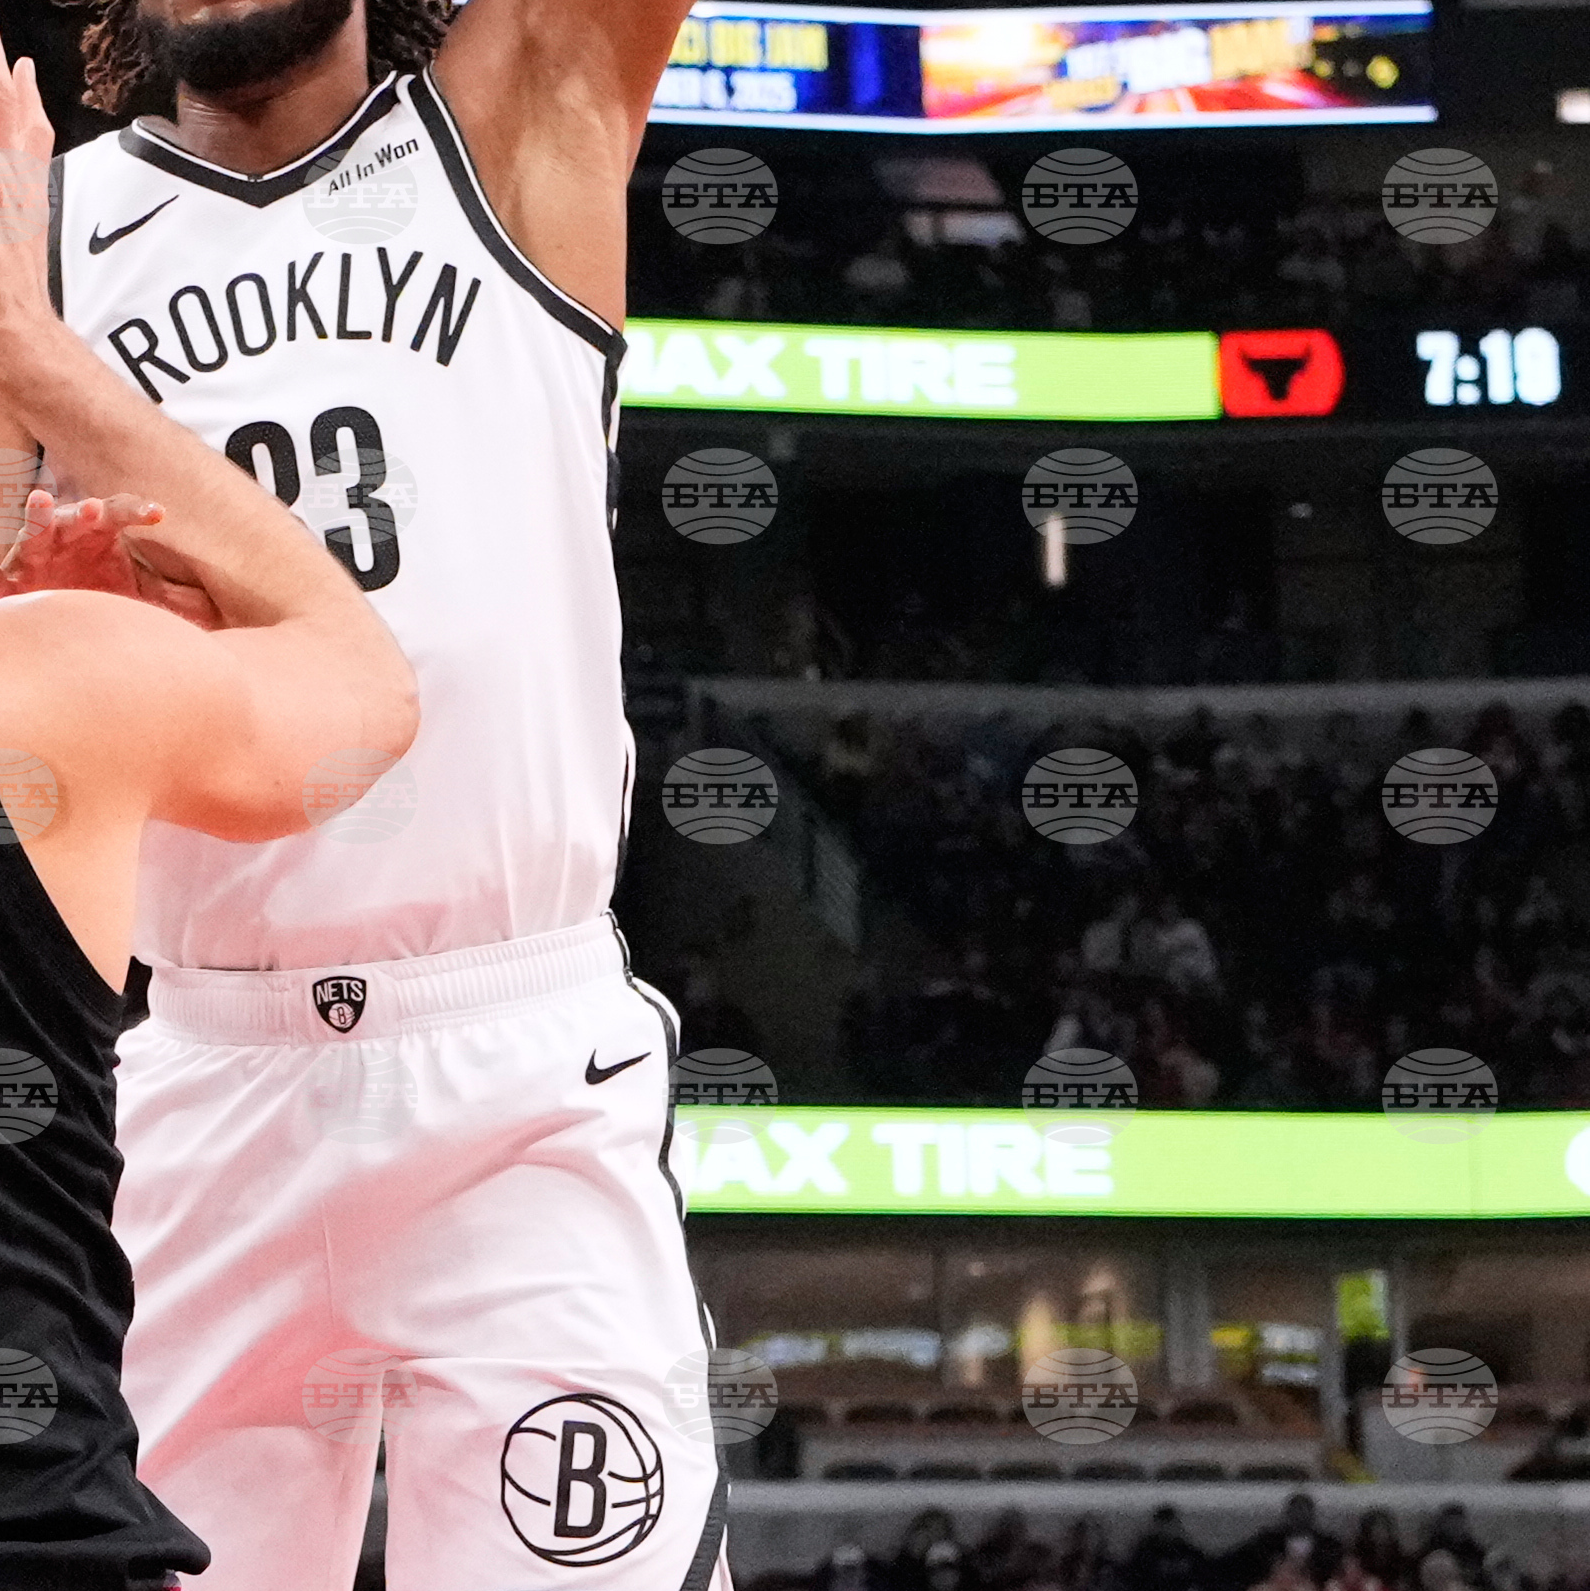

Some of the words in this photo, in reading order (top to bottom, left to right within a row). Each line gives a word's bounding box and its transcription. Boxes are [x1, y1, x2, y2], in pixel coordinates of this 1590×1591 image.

[328, 170, 351, 196] All
[356, 163, 375, 181] In
[374, 138, 420, 169] Won
[108, 247, 482, 405] ROOKLYN
[803, 336, 1019, 407] TIRE
[316, 979, 364, 1006] NETS
[686, 1119, 850, 1197] AX
[871, 1121, 1114, 1197] TIRE
[554, 1420, 607, 1538] B
